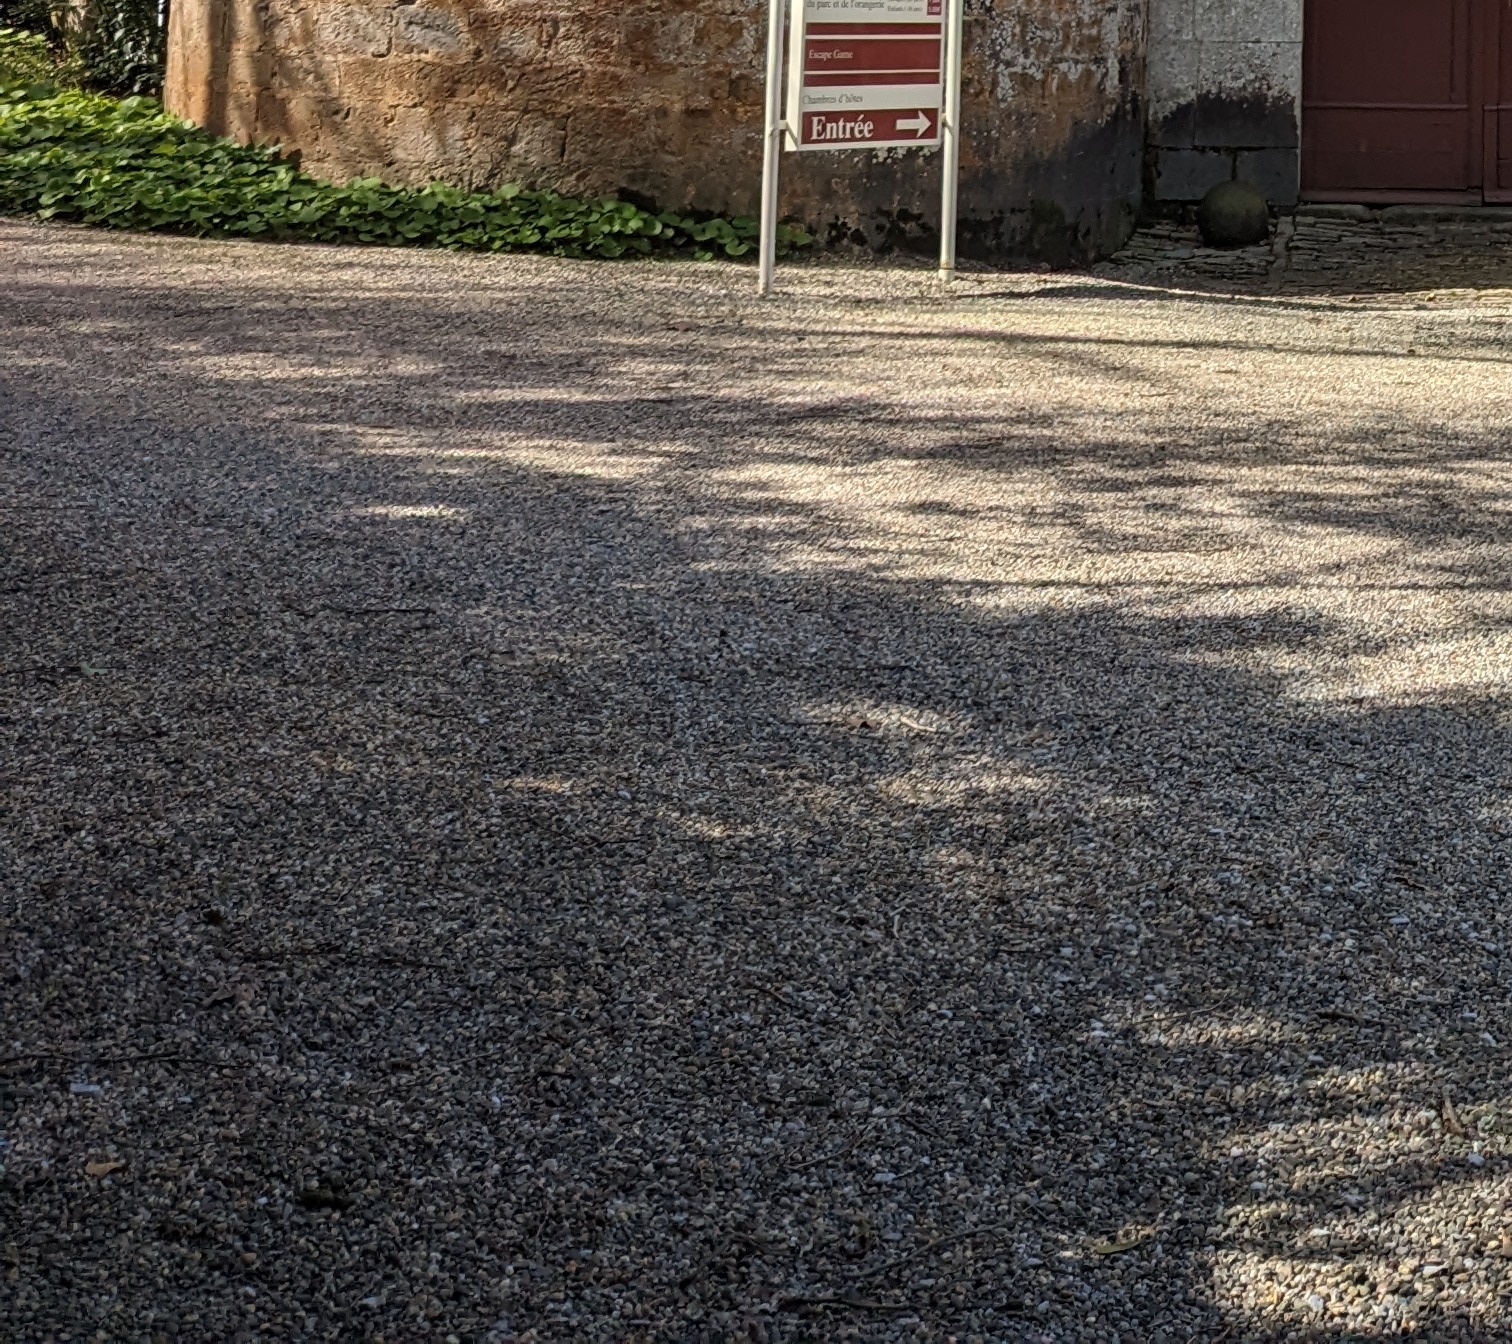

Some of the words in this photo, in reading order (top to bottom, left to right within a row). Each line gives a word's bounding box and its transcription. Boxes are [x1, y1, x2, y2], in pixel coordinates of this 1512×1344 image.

[841, 0, 849, 8] de
[808, 49, 832, 61] Escape
[833, 49, 853, 59] Game
[802, 94, 837, 105] Chambres
[810, 113, 874, 140] Entrée
